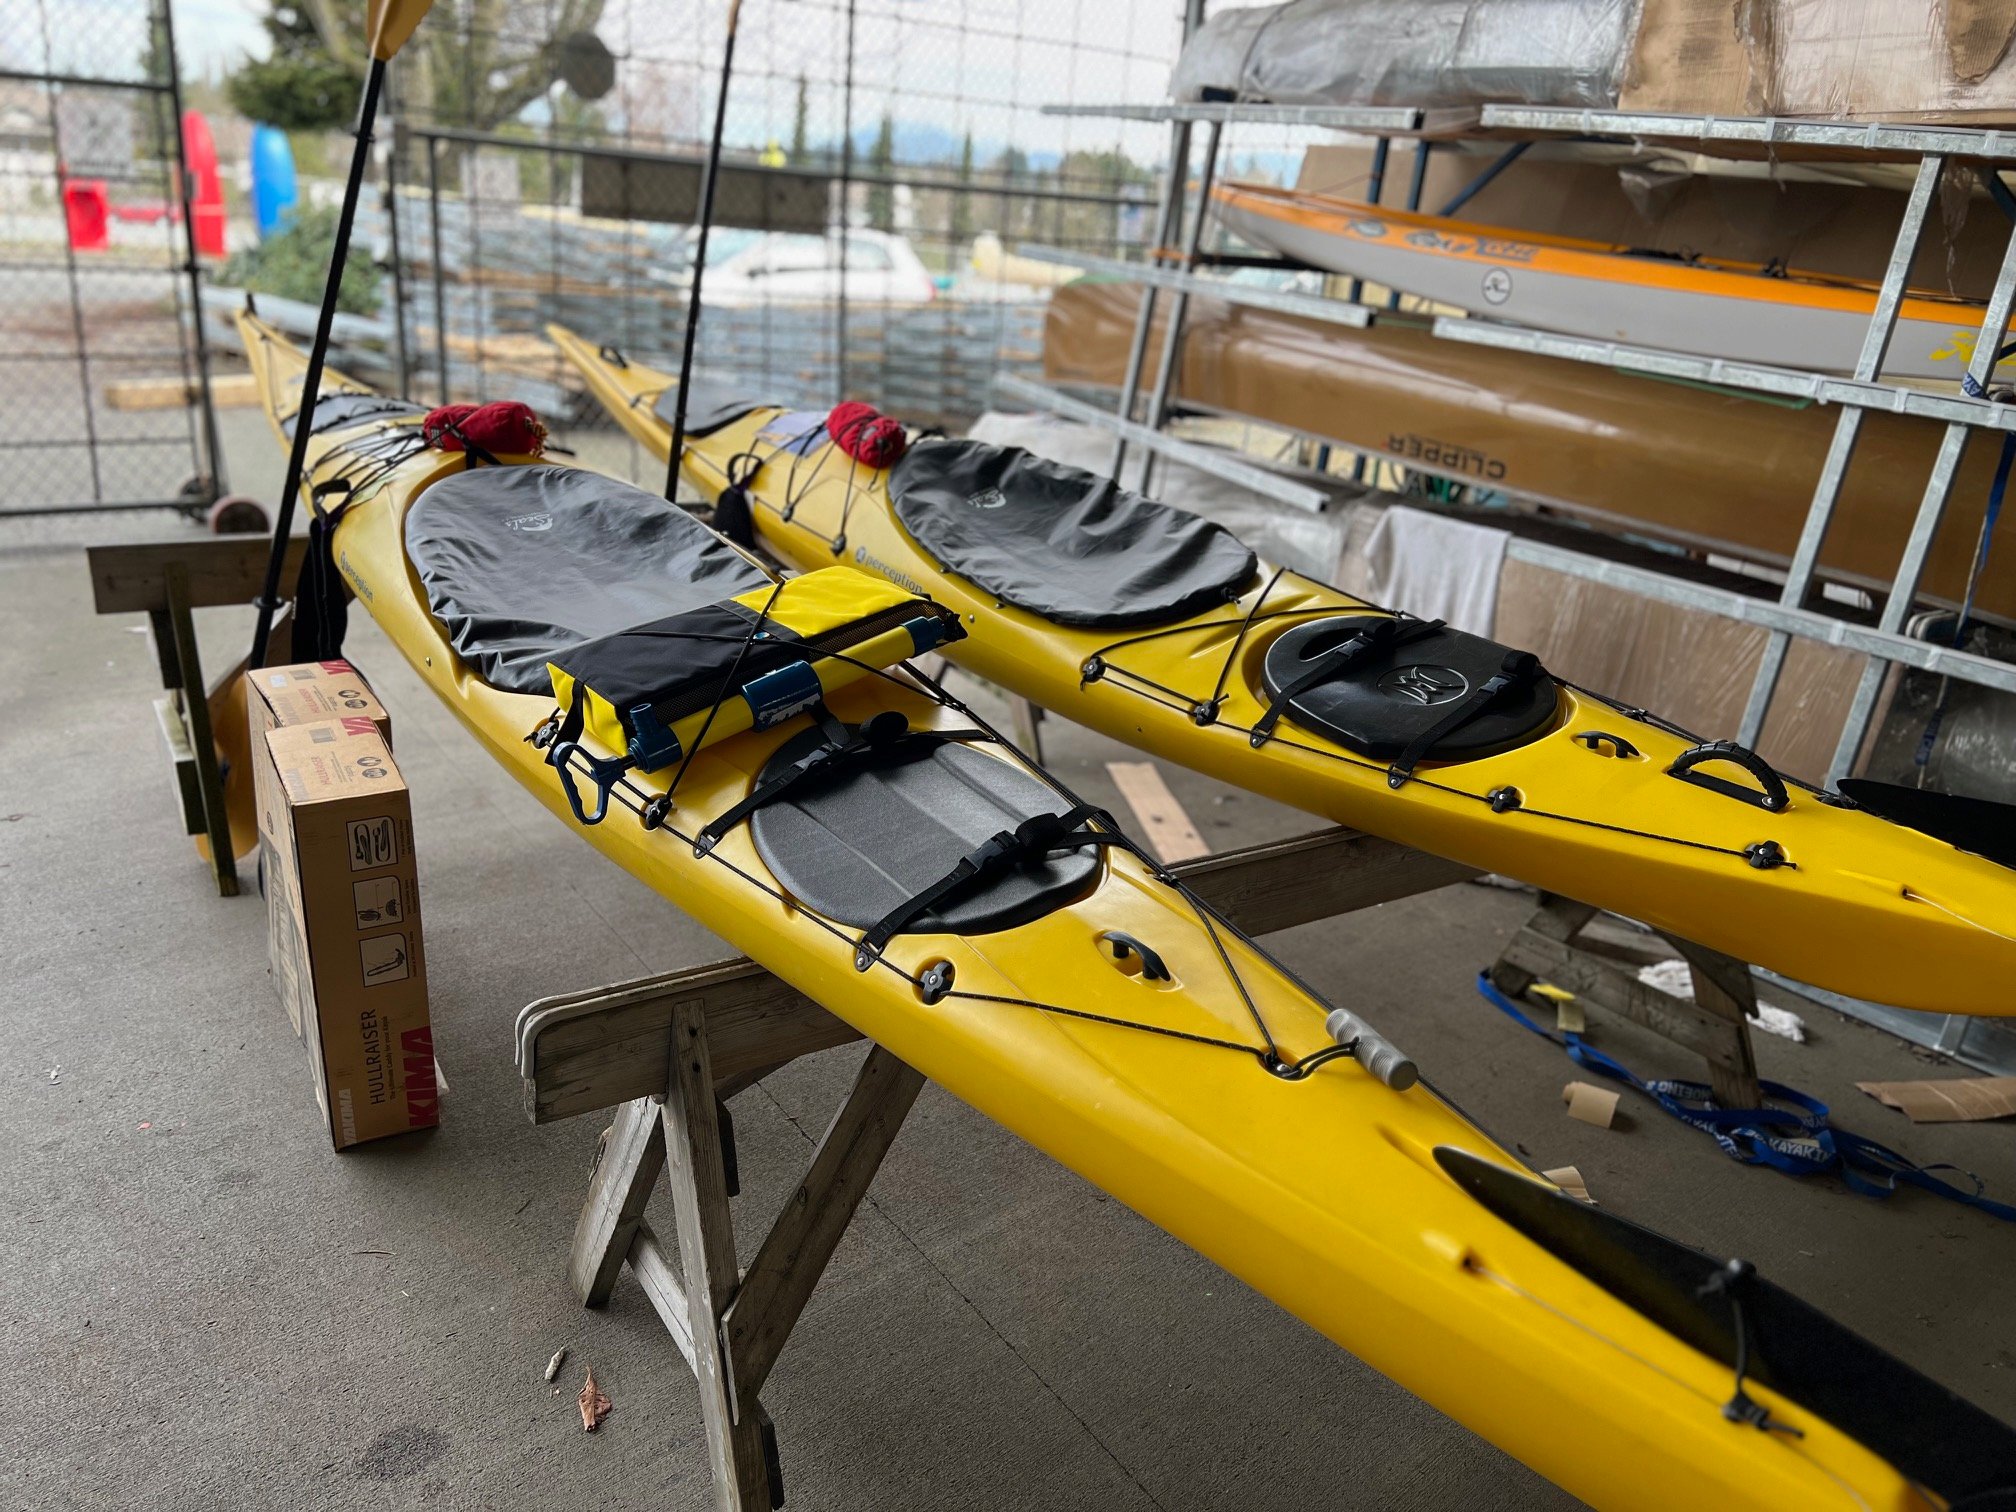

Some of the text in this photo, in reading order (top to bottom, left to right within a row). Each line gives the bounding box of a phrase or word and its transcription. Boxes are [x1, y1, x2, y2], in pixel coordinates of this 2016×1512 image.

[1388, 435, 1506, 481] CLIPPER
[865, 555, 924, 593] perception
[360, 1008, 386, 1105] HULLRAISER
[401, 1025, 439, 1128] KIMA
[338, 1088, 358, 1145] YAKIMA
